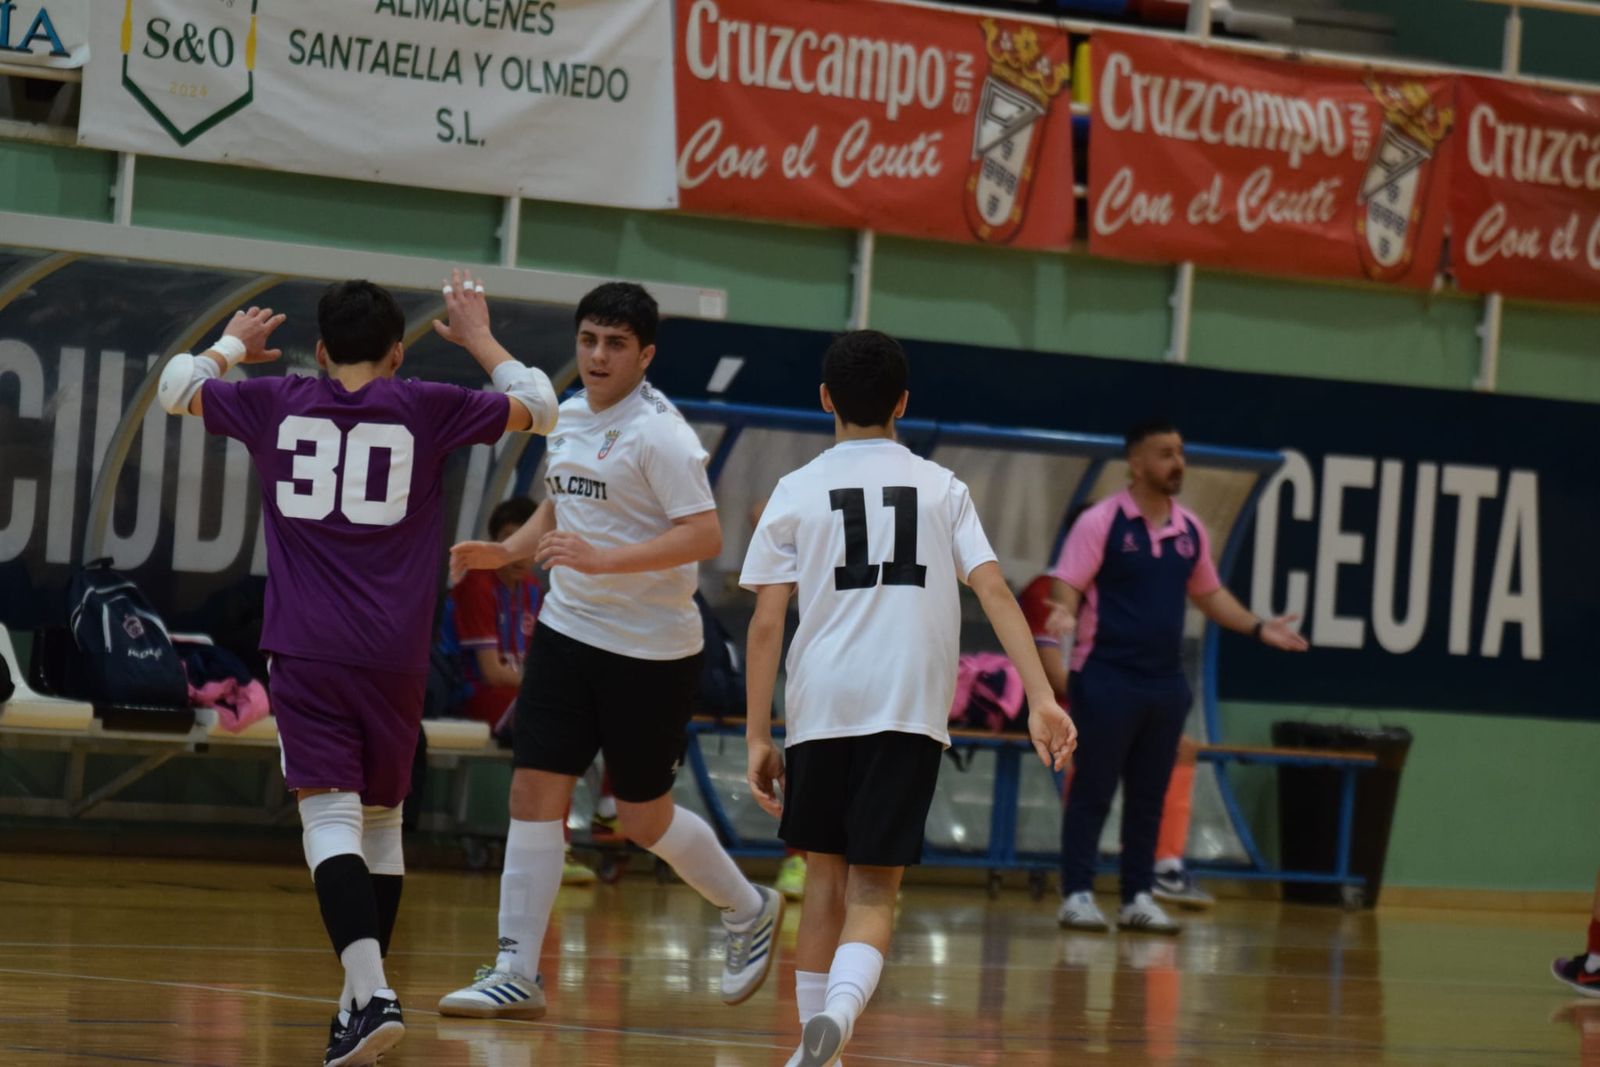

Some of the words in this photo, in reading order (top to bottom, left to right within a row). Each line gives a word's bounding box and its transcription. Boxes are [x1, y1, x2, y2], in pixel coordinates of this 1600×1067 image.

[143, 17, 234, 68] S&O
[288, 29, 462, 85] SANTAELLA
[474, 53, 492, 87] Y
[501, 56, 629, 102] OLMEDO
[686, 0, 946, 121] Cruzcampo
[436, 108, 485, 147] S.L.
[1100, 52, 1347, 169] Cruzcampo
[677, 118, 767, 189] Con
[782, 124, 819, 180] el
[1094, 167, 1173, 236] Con
[1187, 173, 1225, 225] el
[1465, 203, 1542, 266] Con
[1550, 212, 1580, 260] el
[275, 415, 415, 527] 30
[828, 485, 928, 592] 11
[1250, 448, 1543, 661] CEUTA
